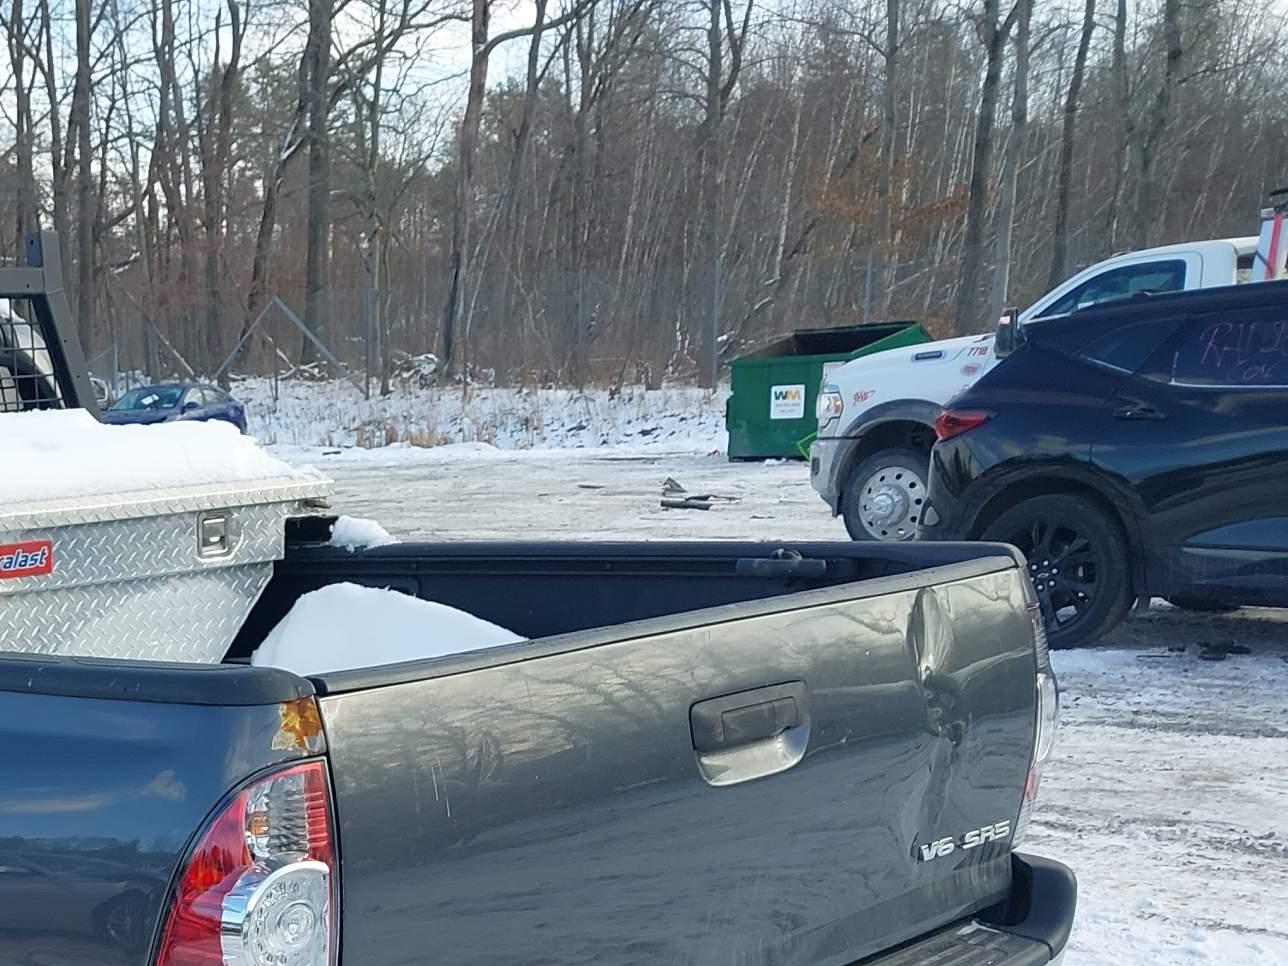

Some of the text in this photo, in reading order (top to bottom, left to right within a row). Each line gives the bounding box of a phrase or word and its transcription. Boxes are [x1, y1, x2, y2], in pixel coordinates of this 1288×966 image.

[774, 389, 801, 401] WM
[920, 819, 1010, 862] V6 SR5
